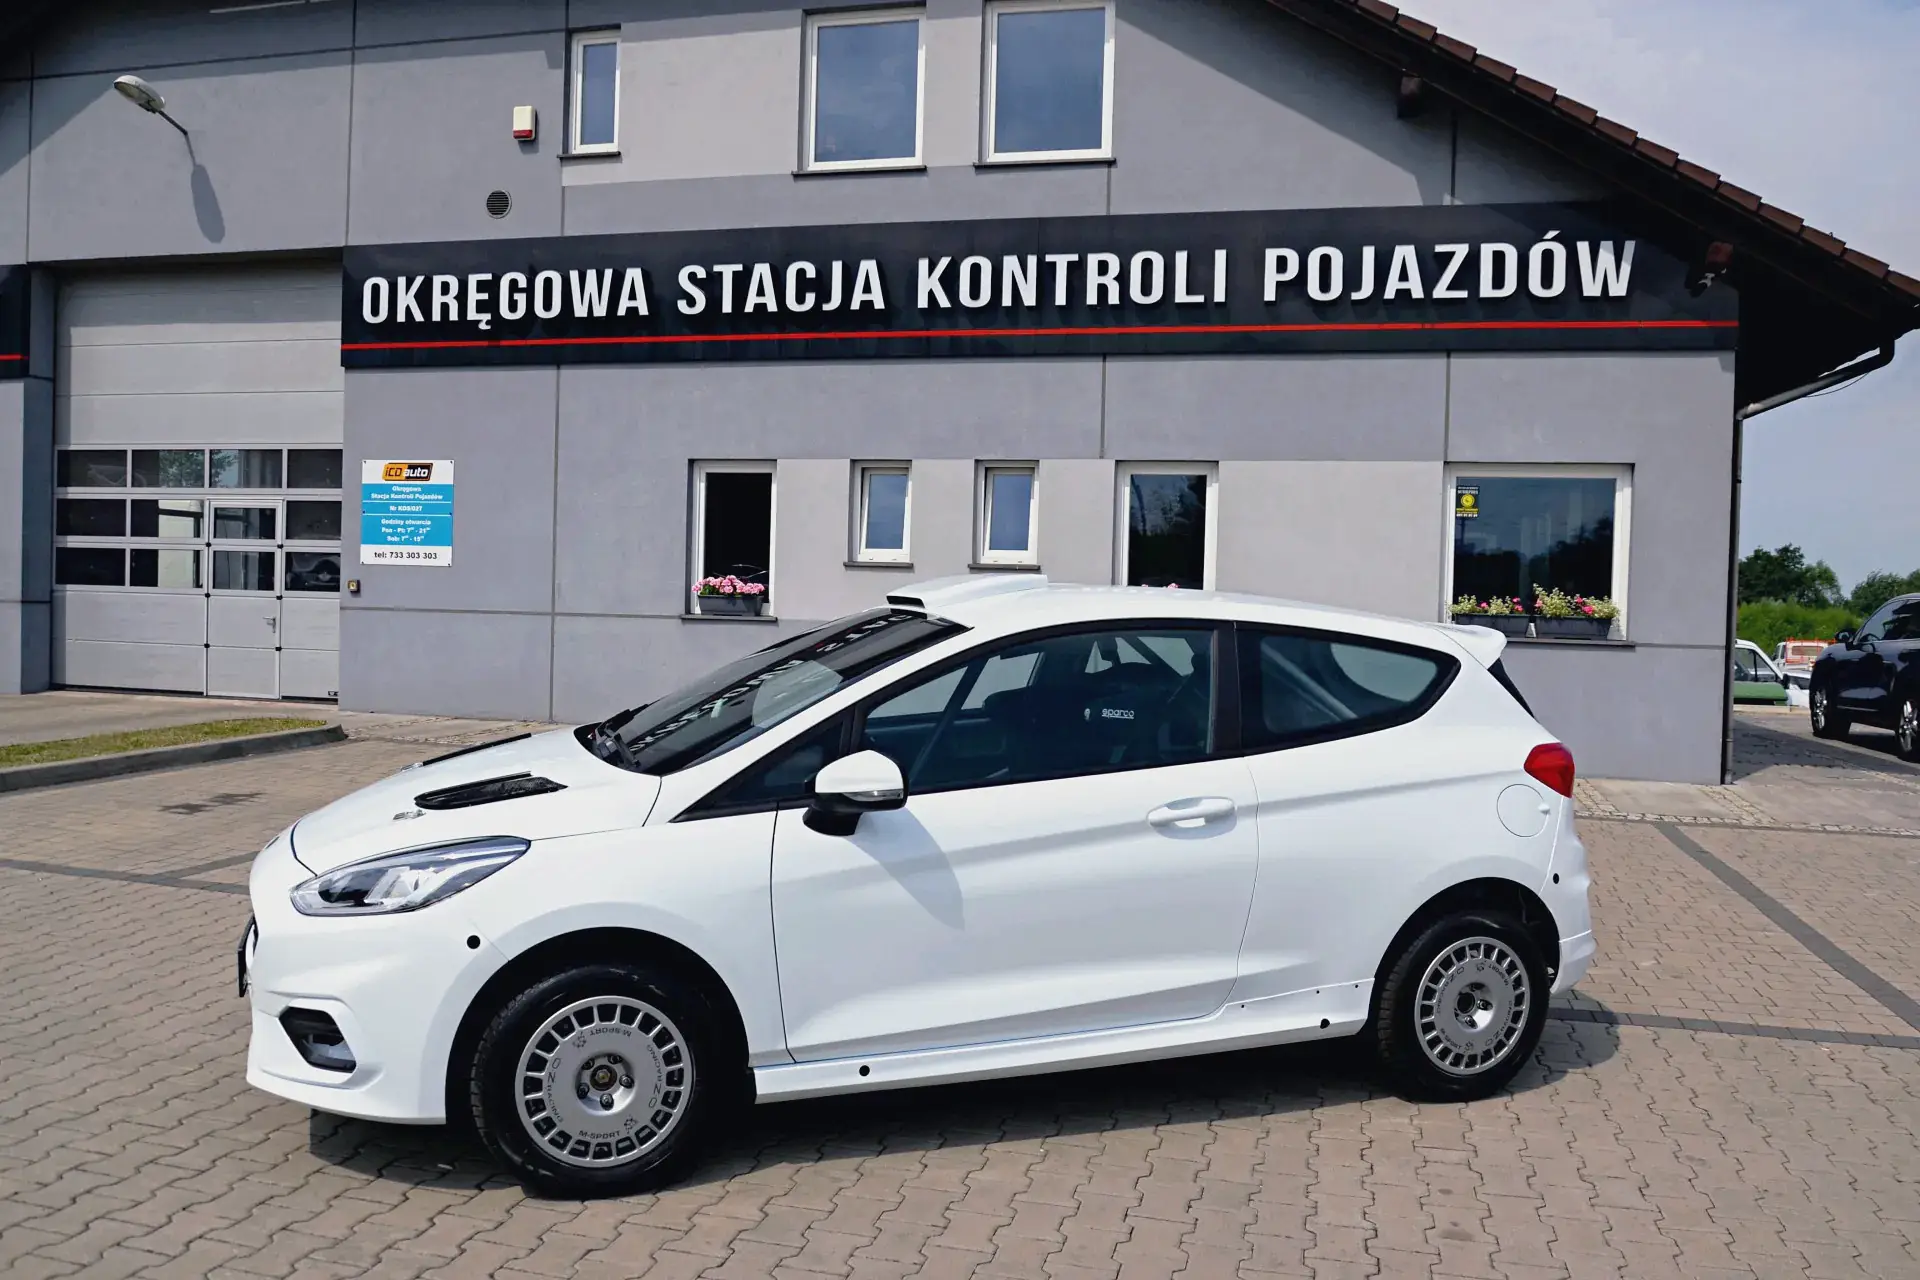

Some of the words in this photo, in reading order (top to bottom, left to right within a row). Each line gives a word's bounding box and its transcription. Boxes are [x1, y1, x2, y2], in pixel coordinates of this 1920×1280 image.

[362, 267, 650, 330] OKRĘGOWA
[676, 259, 887, 315] STACJA
[916, 249, 1228, 310] KONTROLI
[1263, 230, 1637, 301] POJAZDÓW
[1102, 708, 1134, 718] sparco
[579, 1130, 620, 1139] M-SPORT
